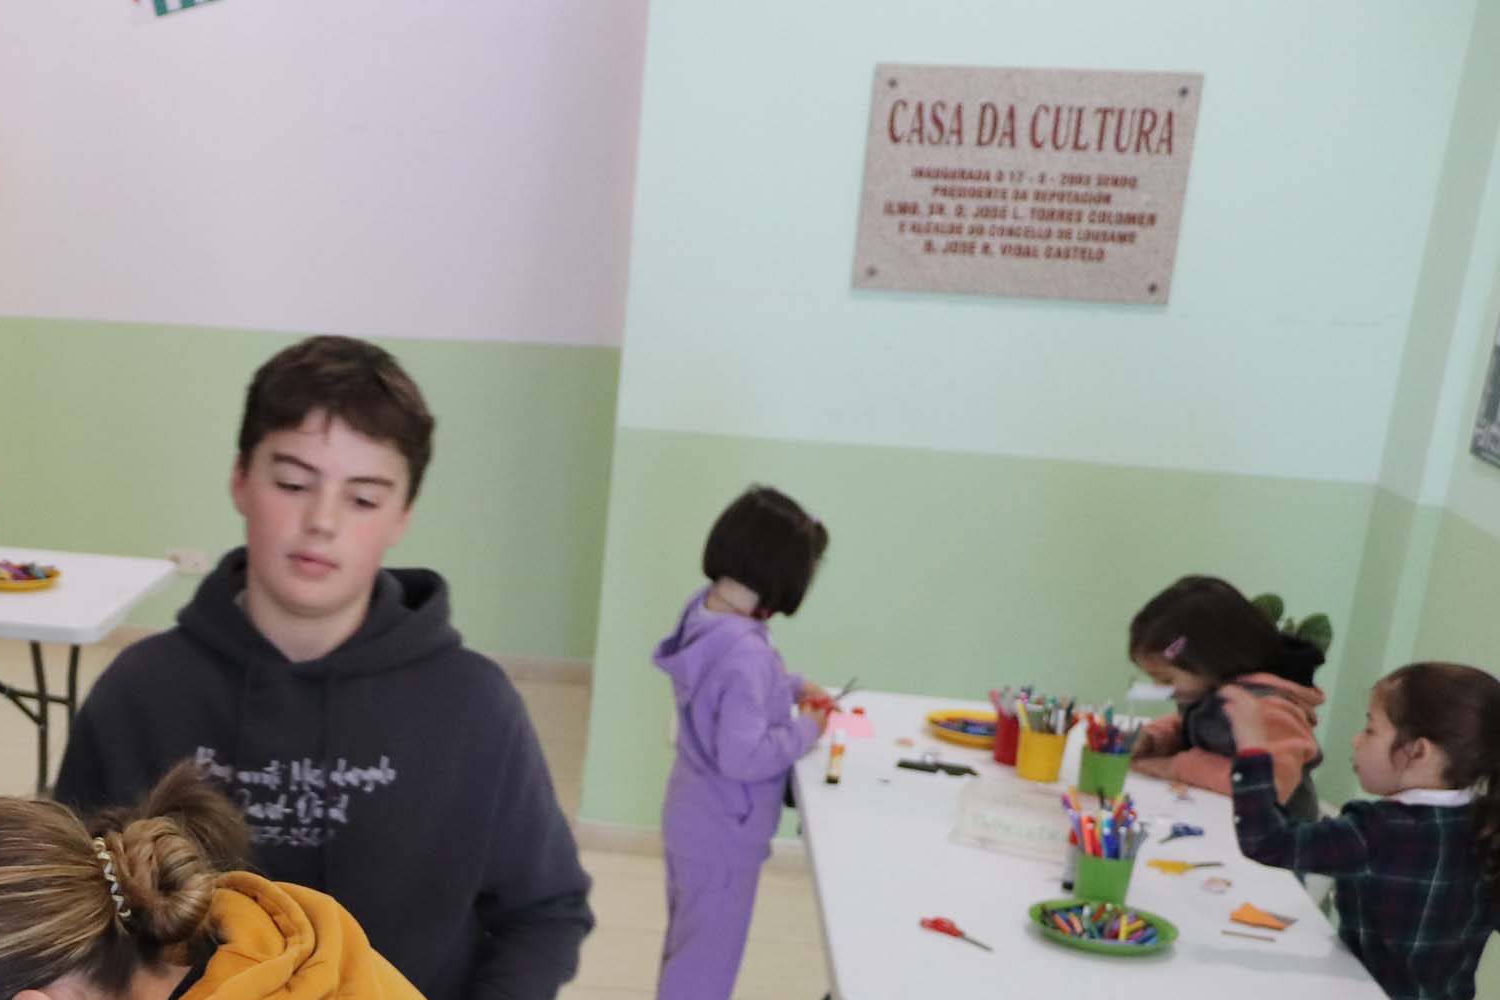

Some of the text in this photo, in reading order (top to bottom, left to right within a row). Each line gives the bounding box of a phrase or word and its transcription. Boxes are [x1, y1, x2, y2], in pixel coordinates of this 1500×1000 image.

[887, 100, 1174, 156] CASA DA CULTURA
